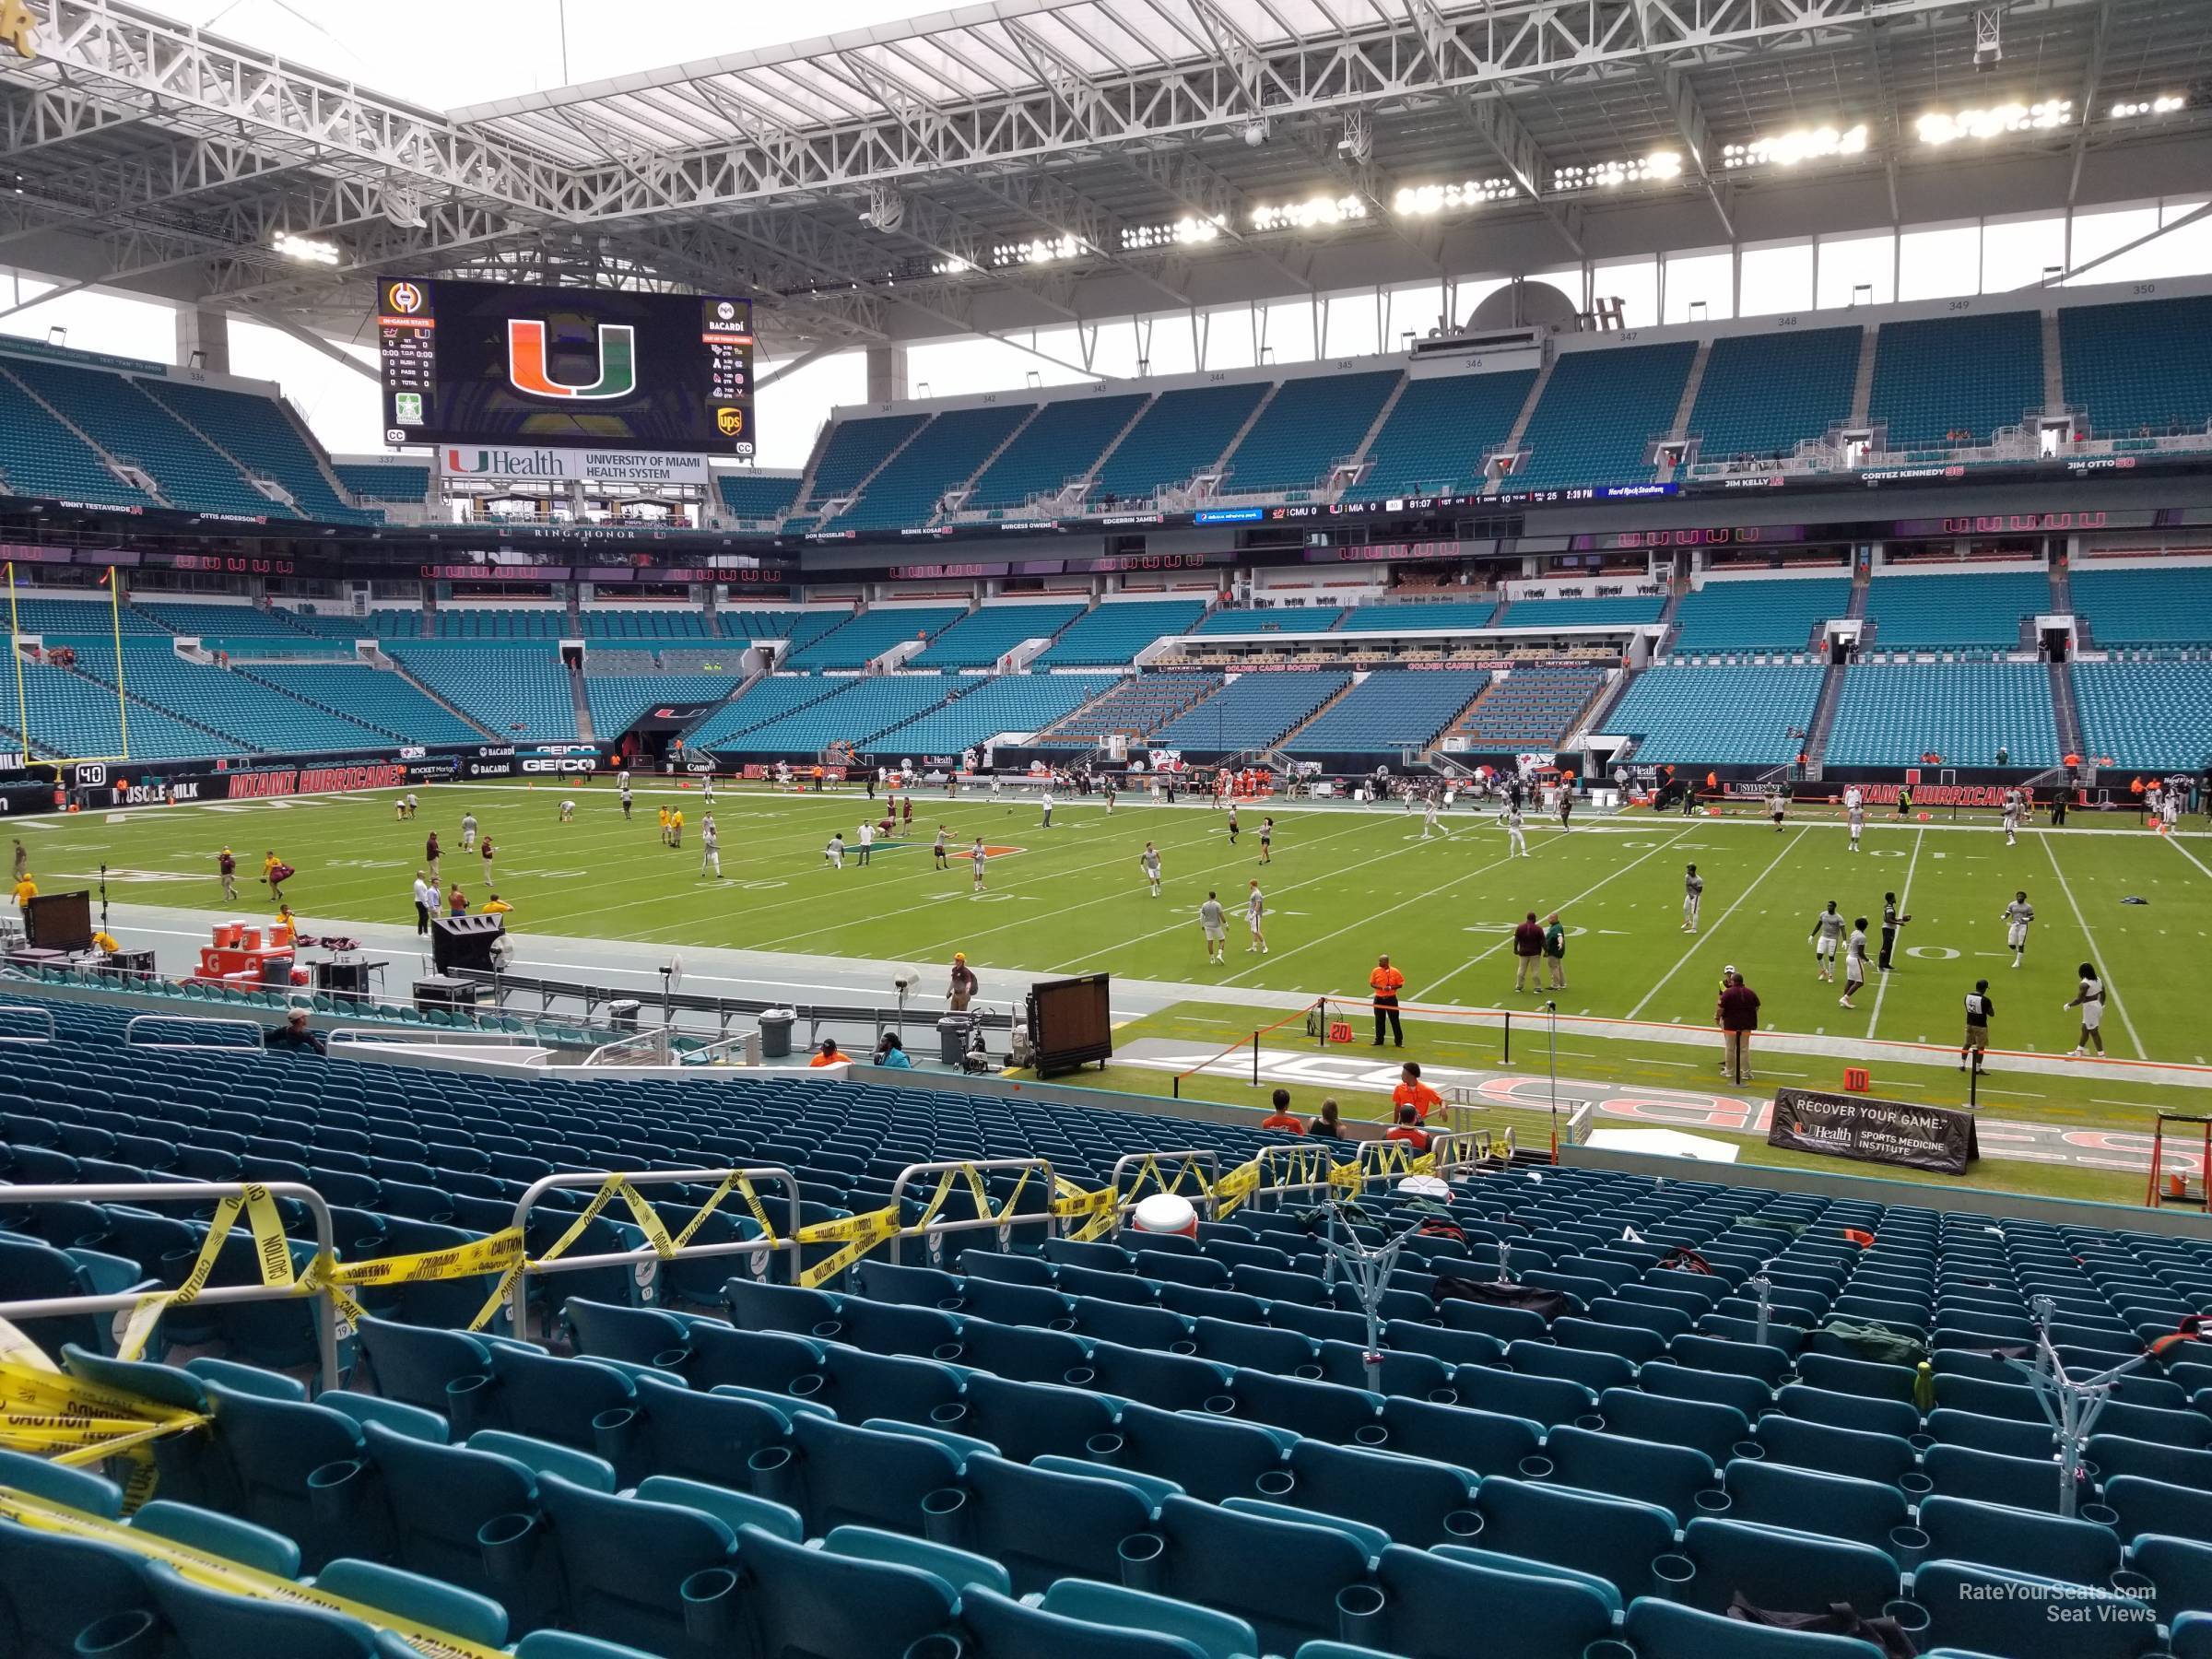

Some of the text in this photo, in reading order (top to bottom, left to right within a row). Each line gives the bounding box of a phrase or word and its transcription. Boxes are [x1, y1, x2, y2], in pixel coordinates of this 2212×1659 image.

[2133, 285, 2155, 295] 350
[1948, 300, 1970, 311] 349
[1778, 317, 1797, 326] 348
[1620, 333, 1637, 341] 347
[507, 318, 637, 400] U
[1465, 359, 1483, 369] 346
[1337, 360, 1352, 370] 345
[191, 372, 205, 382] 336
[1210, 373, 1225, 382] 344
[1093, 384, 1106, 393] 343
[983, 394, 995, 403] 342
[389, 431, 403, 440] CC
[379, 455, 394, 465] 337
[586, 453, 700, 467] UNIVERSITY OF MIAMI
[2067, 462, 2085, 470] JIM
[2088, 460, 2114, 468] OTTO
[586, 466, 670, 479] HEALTH SYSTEM
[747, 467, 762, 476] 340
[1862, 471, 1898, 480] CORTEZ
[1900, 468, 1945, 478] KENNEDY
[1583, 489, 1593, 499] PM
[1639, 485, 1664, 494] Stadium
[1501, 495, 1511, 503] 10
[85, 502, 130, 512] TESTAVERDE
[1289, 508, 1308, 516] CMU
[1348, 504, 1363, 512] MIA
[535, 529, 571, 537] RING
[584, 531, 635, 539] HONOR
[1225, 665, 1258, 673] GOLDEN
[1287, 664, 1321, 672] SOCIETY
[1407, 662, 1443, 670] GOLDEN
[1477, 661, 1515, 669] SOCIETY
[488, 746, 515, 756] BACARDÍ
[411, 766, 435, 775] ROCKET
[480, 763, 510, 775] BACARDÍ
[688, 763, 712, 772] Cano
[80, 766, 101, 782] 40
[229, 771, 297, 798] MIAMI
[1912, 784, 2034, 806] HURRICANS
[1332, 1025, 1347, 1040] 20
[1849, 1074, 1865, 1089] 10
[1797, 1099, 1855, 1118] RECOVER
[1861, 1108, 1897, 1124] YOUR
[1861, 1131, 1945, 1152] SPORTS MEDICINE
[1859, 1140, 1910, 1156] INSTITUTE
[583, 1187, 613, 1227] CUIDADO
[263, 1234, 288, 1280] CAUTION
